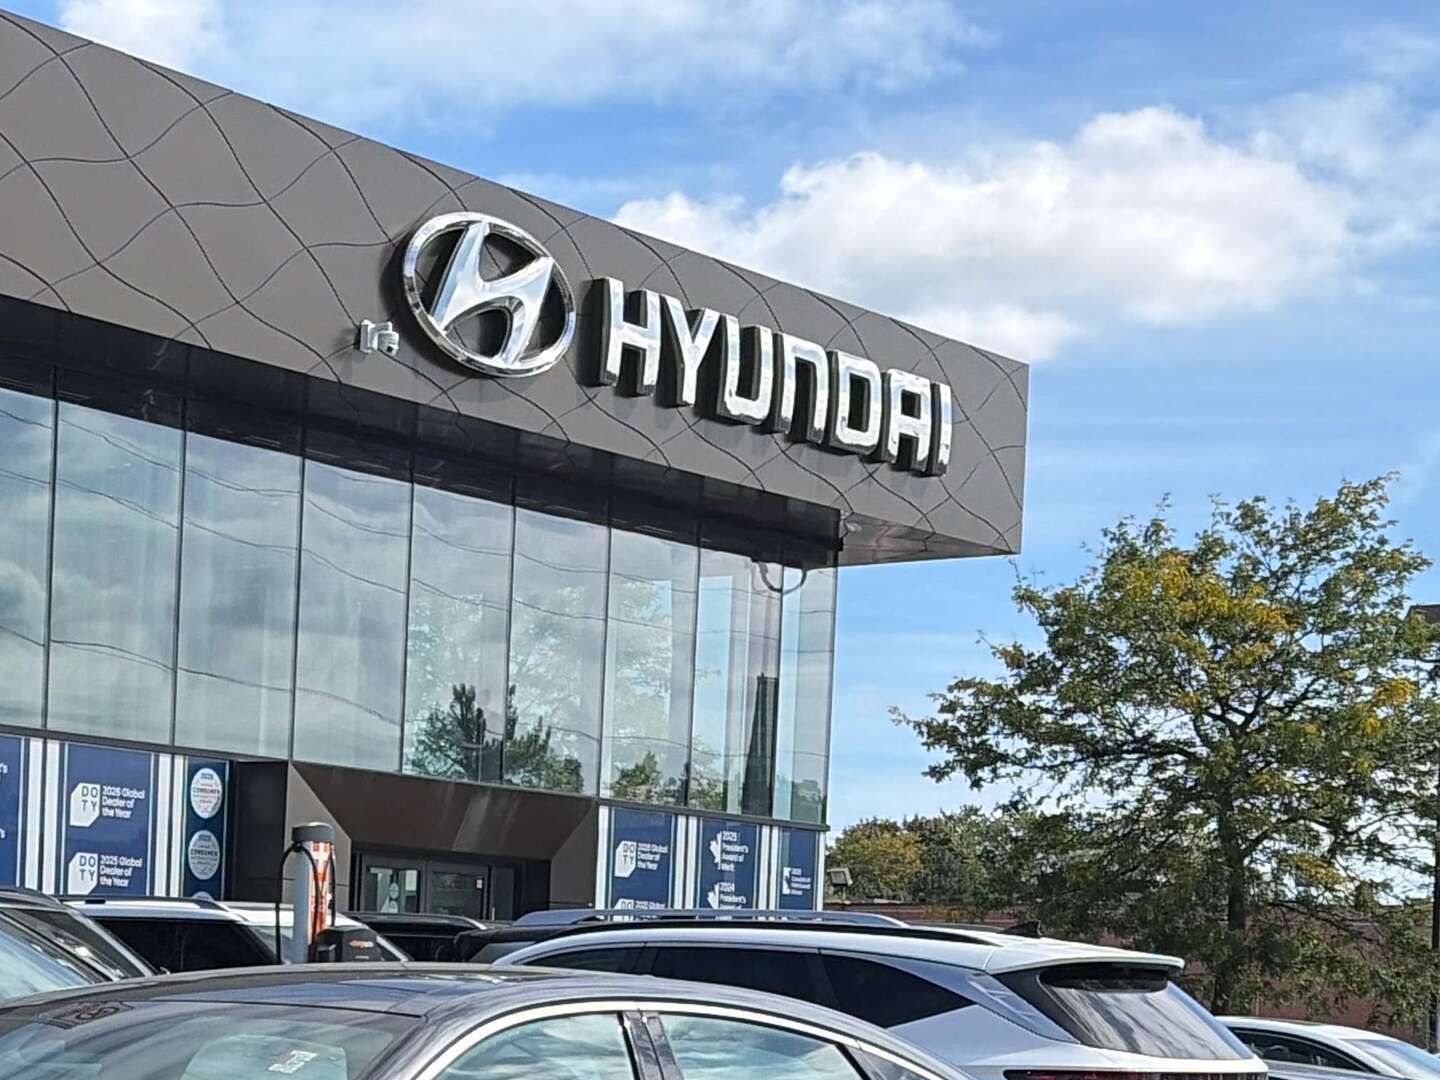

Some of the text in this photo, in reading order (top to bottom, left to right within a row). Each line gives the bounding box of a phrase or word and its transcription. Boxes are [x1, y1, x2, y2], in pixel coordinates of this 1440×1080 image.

[602, 276, 953, 477] HYUNDAI
[81, 786, 99, 798] DO
[121, 787, 146, 799] Global
[81, 800, 98, 812] TY
[102, 796, 135, 808] Dealer of
[102, 807, 132, 819] the Year
[79, 856, 96, 867] DO
[119, 856, 143, 867] Global
[79, 869, 96, 880] TY
[100, 865, 133, 877] Dealer of
[112, 877, 129, 887] Year
